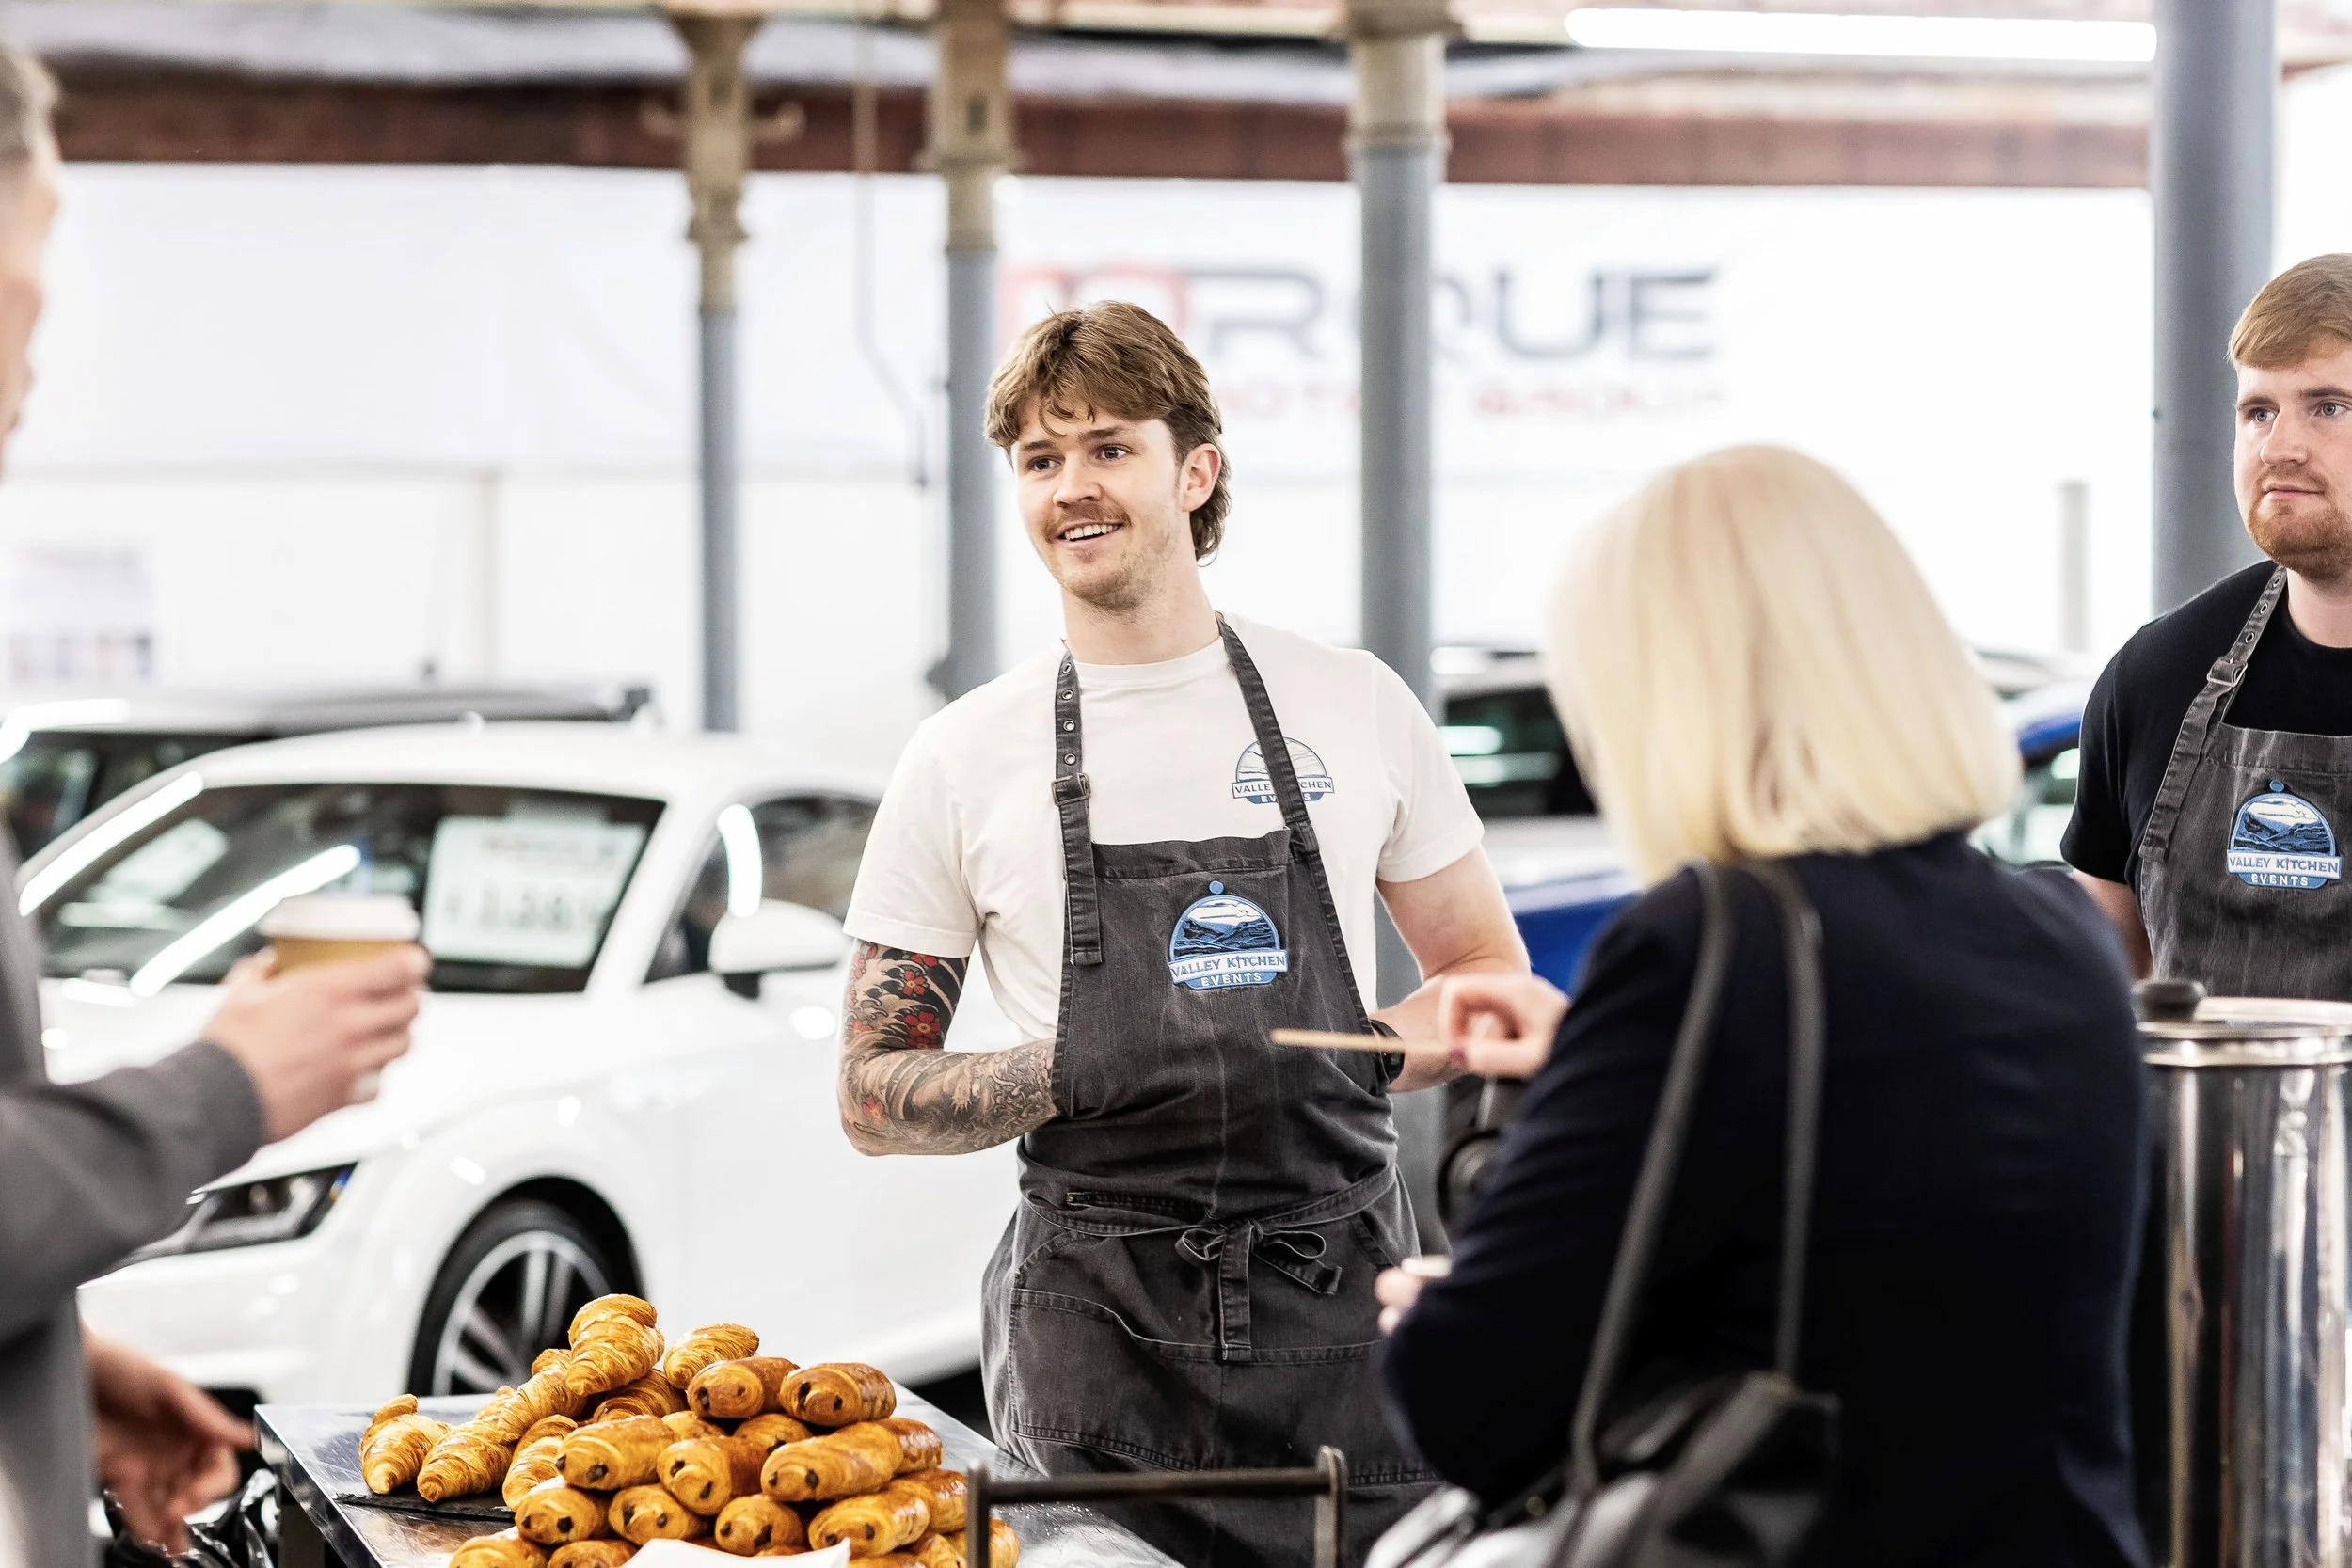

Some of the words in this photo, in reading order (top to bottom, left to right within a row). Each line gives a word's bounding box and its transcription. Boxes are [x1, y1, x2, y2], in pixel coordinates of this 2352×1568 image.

[1234, 784, 1271, 794] VALLE
[1261, 793, 1311, 802] EVS
[2230, 857, 2271, 868] VALLEY
[2276, 857, 2339, 873] KITCHEN
[2251, 873, 2309, 886] EVENTS
[1170, 958, 1221, 977] VALLEY
[1227, 955, 1286, 968] KITCHEN
[1200, 972, 1263, 987] EVENTS
